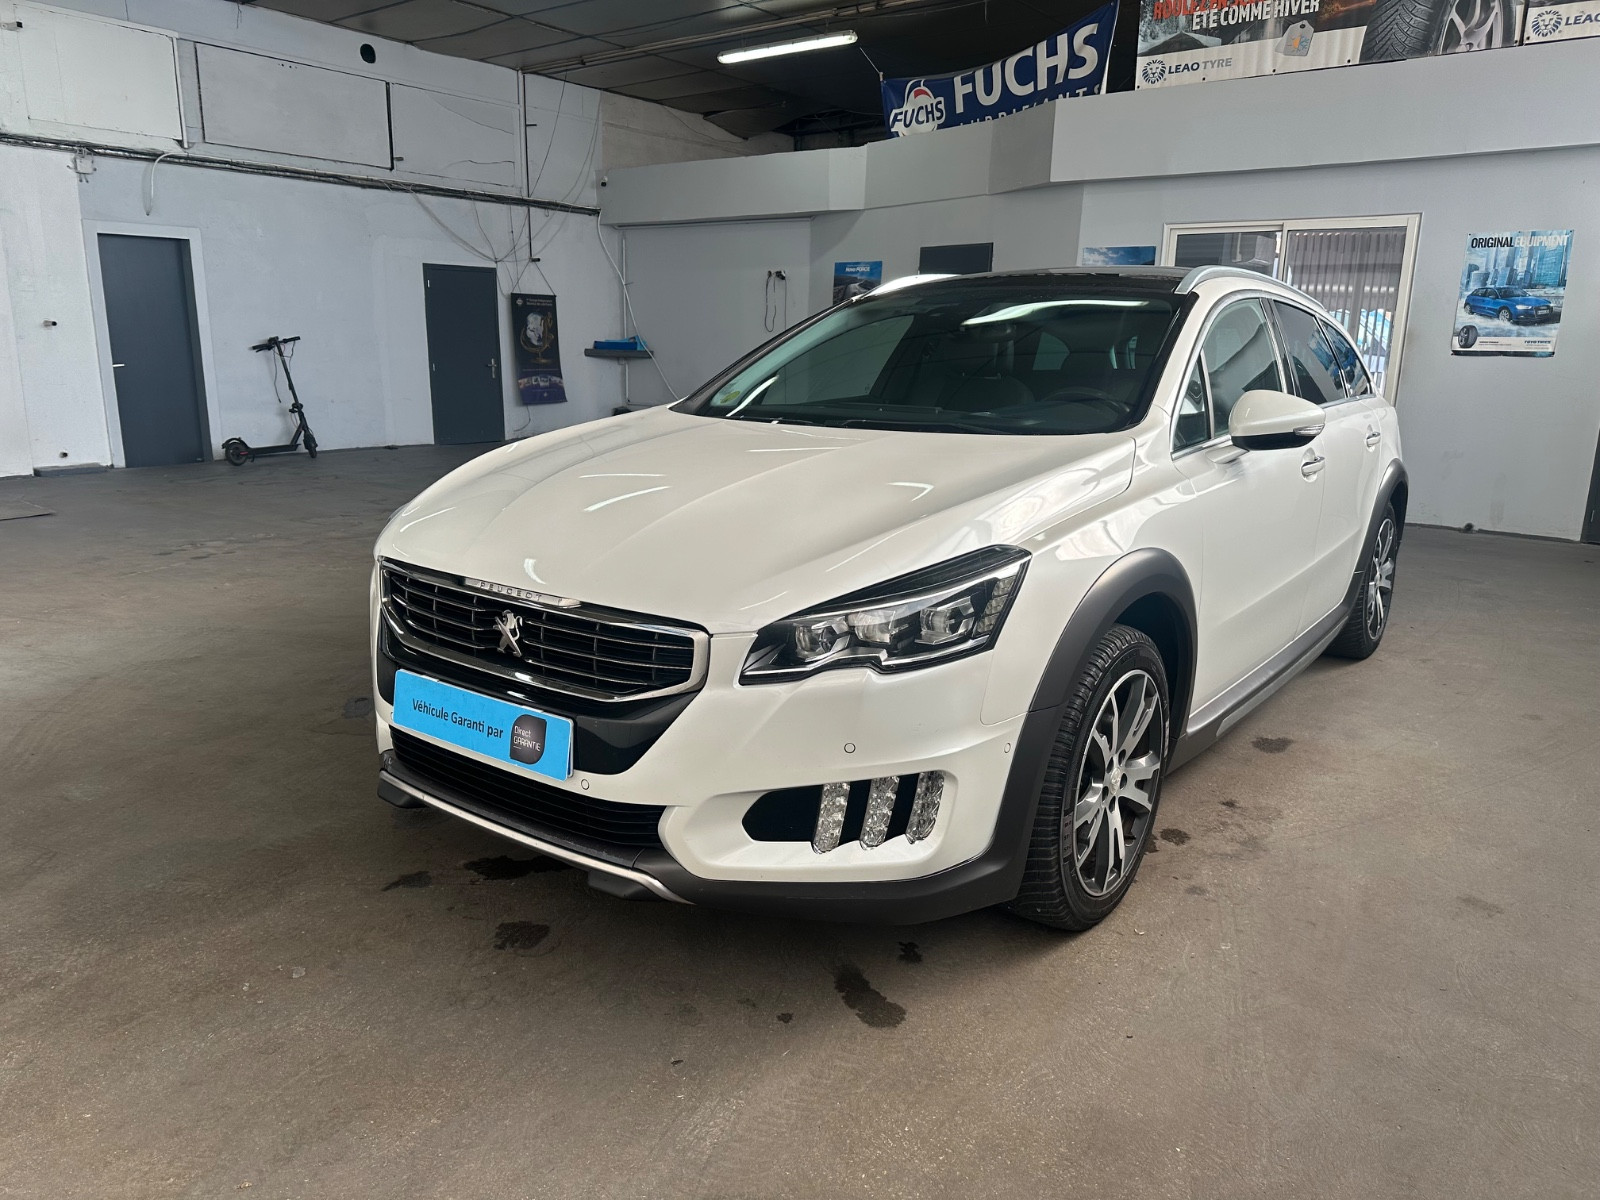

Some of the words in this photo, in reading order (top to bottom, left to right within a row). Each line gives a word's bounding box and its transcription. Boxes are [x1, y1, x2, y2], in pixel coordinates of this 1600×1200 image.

[1192, 3, 1218, 30] ÉTÉ
[1220, 1, 1271, 26] COMME
[1273, 0, 1320, 18] HIVER
[953, 23, 1099, 114] FUCHS
[1168, 62, 1201, 74] LEAO
[1202, 58, 1232, 70] TYRE
[890, 100, 944, 128] FUCHS
[1471, 236, 1514, 249] ORIGINAL
[480, 581, 542, 601] PEUGEOT
[412, 698, 449, 721] Véhicule
[450, 711, 485, 733] Garanti
[486, 725, 504, 739] par
[514, 725, 531, 738] Direct
